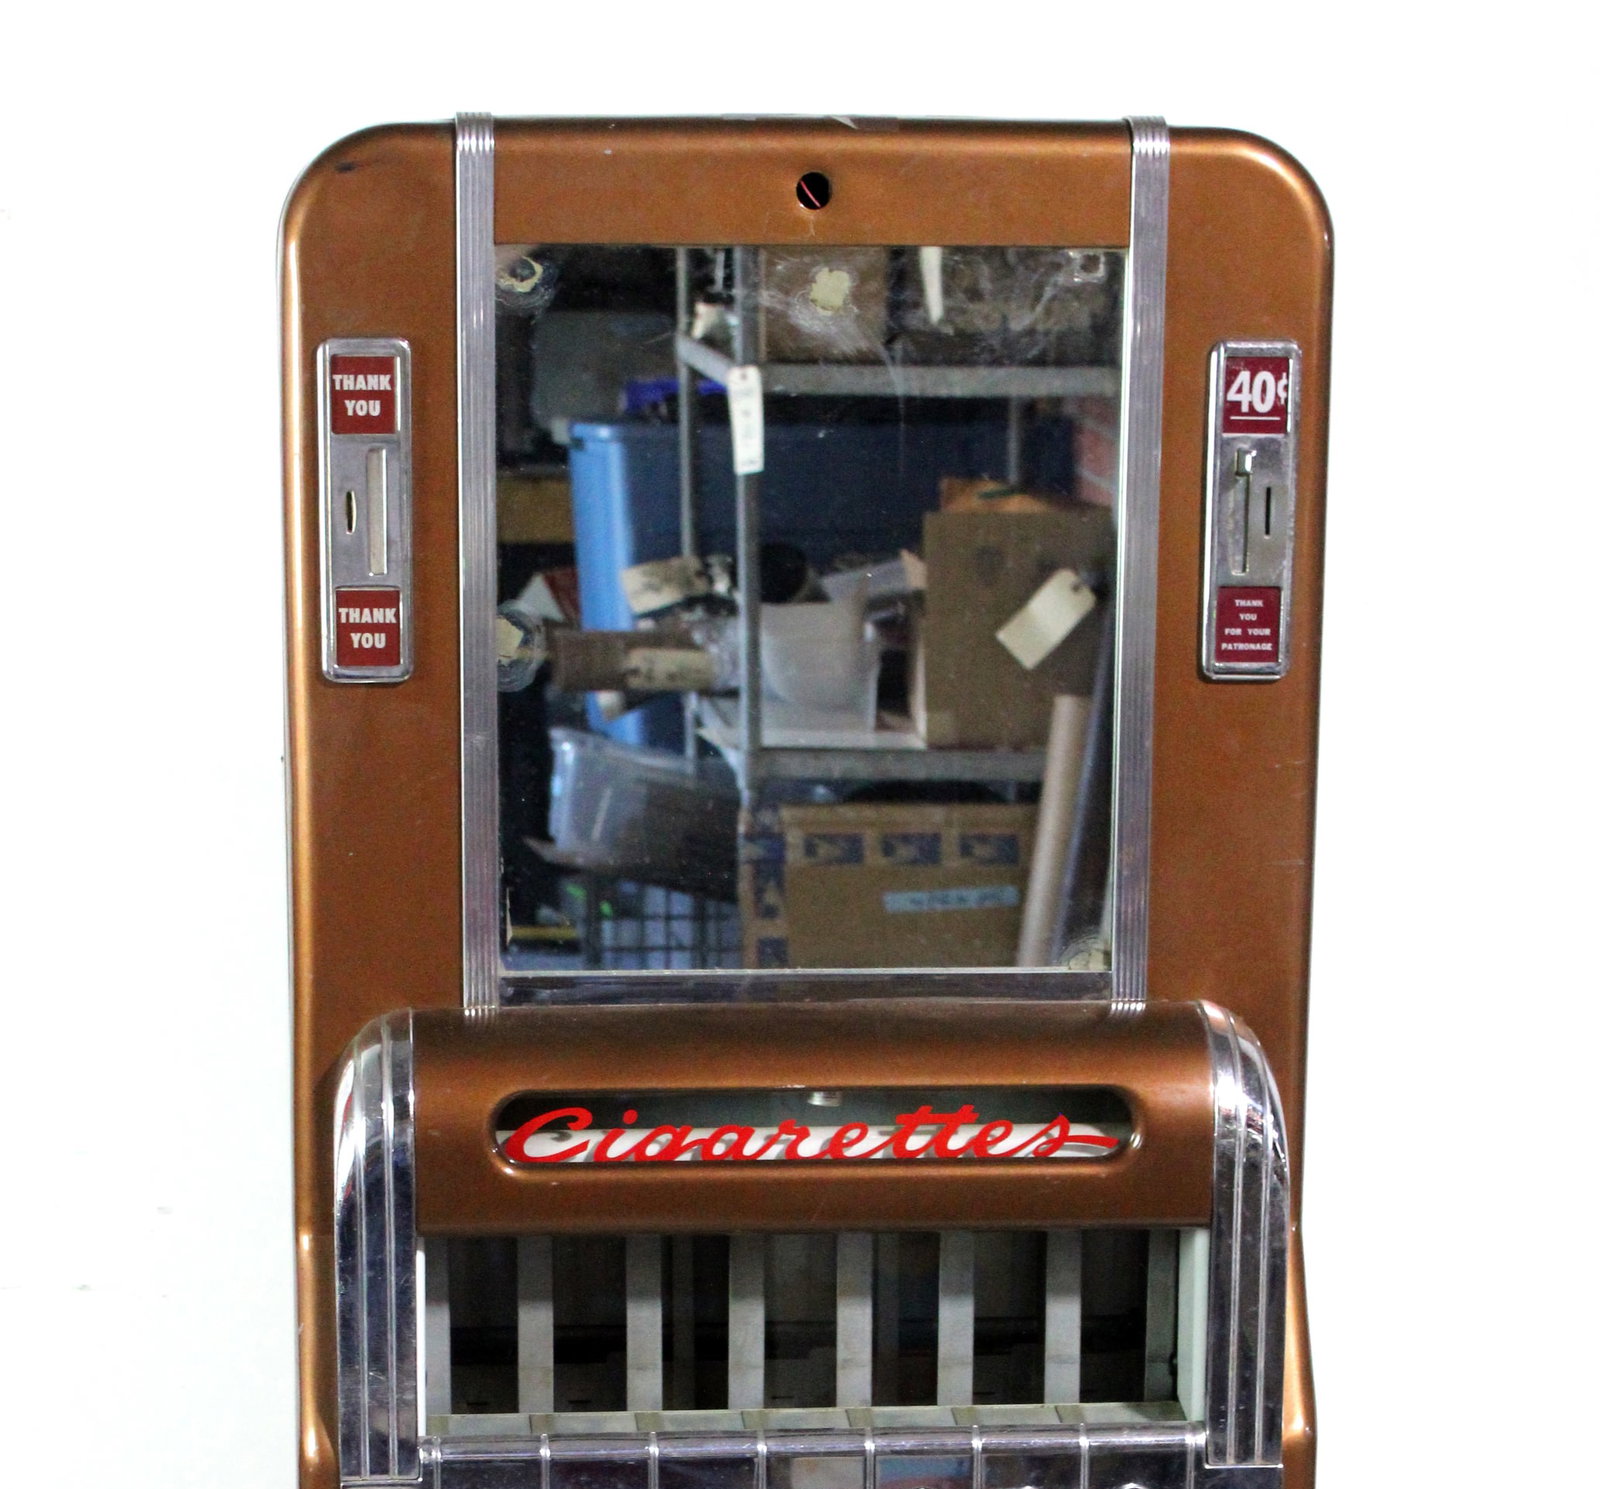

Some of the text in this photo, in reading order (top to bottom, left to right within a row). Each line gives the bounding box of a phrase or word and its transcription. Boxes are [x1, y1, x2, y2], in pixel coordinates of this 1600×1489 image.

[332, 374, 392, 391] THANK
[344, 400, 381, 416] YOU
[1234, 599, 1264, 607] THANK
[338, 608, 397, 624] THANK
[1239, 613, 1258, 621] YOU
[1224, 628, 1271, 636] FOR YOUR
[350, 632, 386, 649] YOU
[1221, 642, 1272, 651] PATRONAGE
[503, 1103, 1120, 1162] Cigarettes
